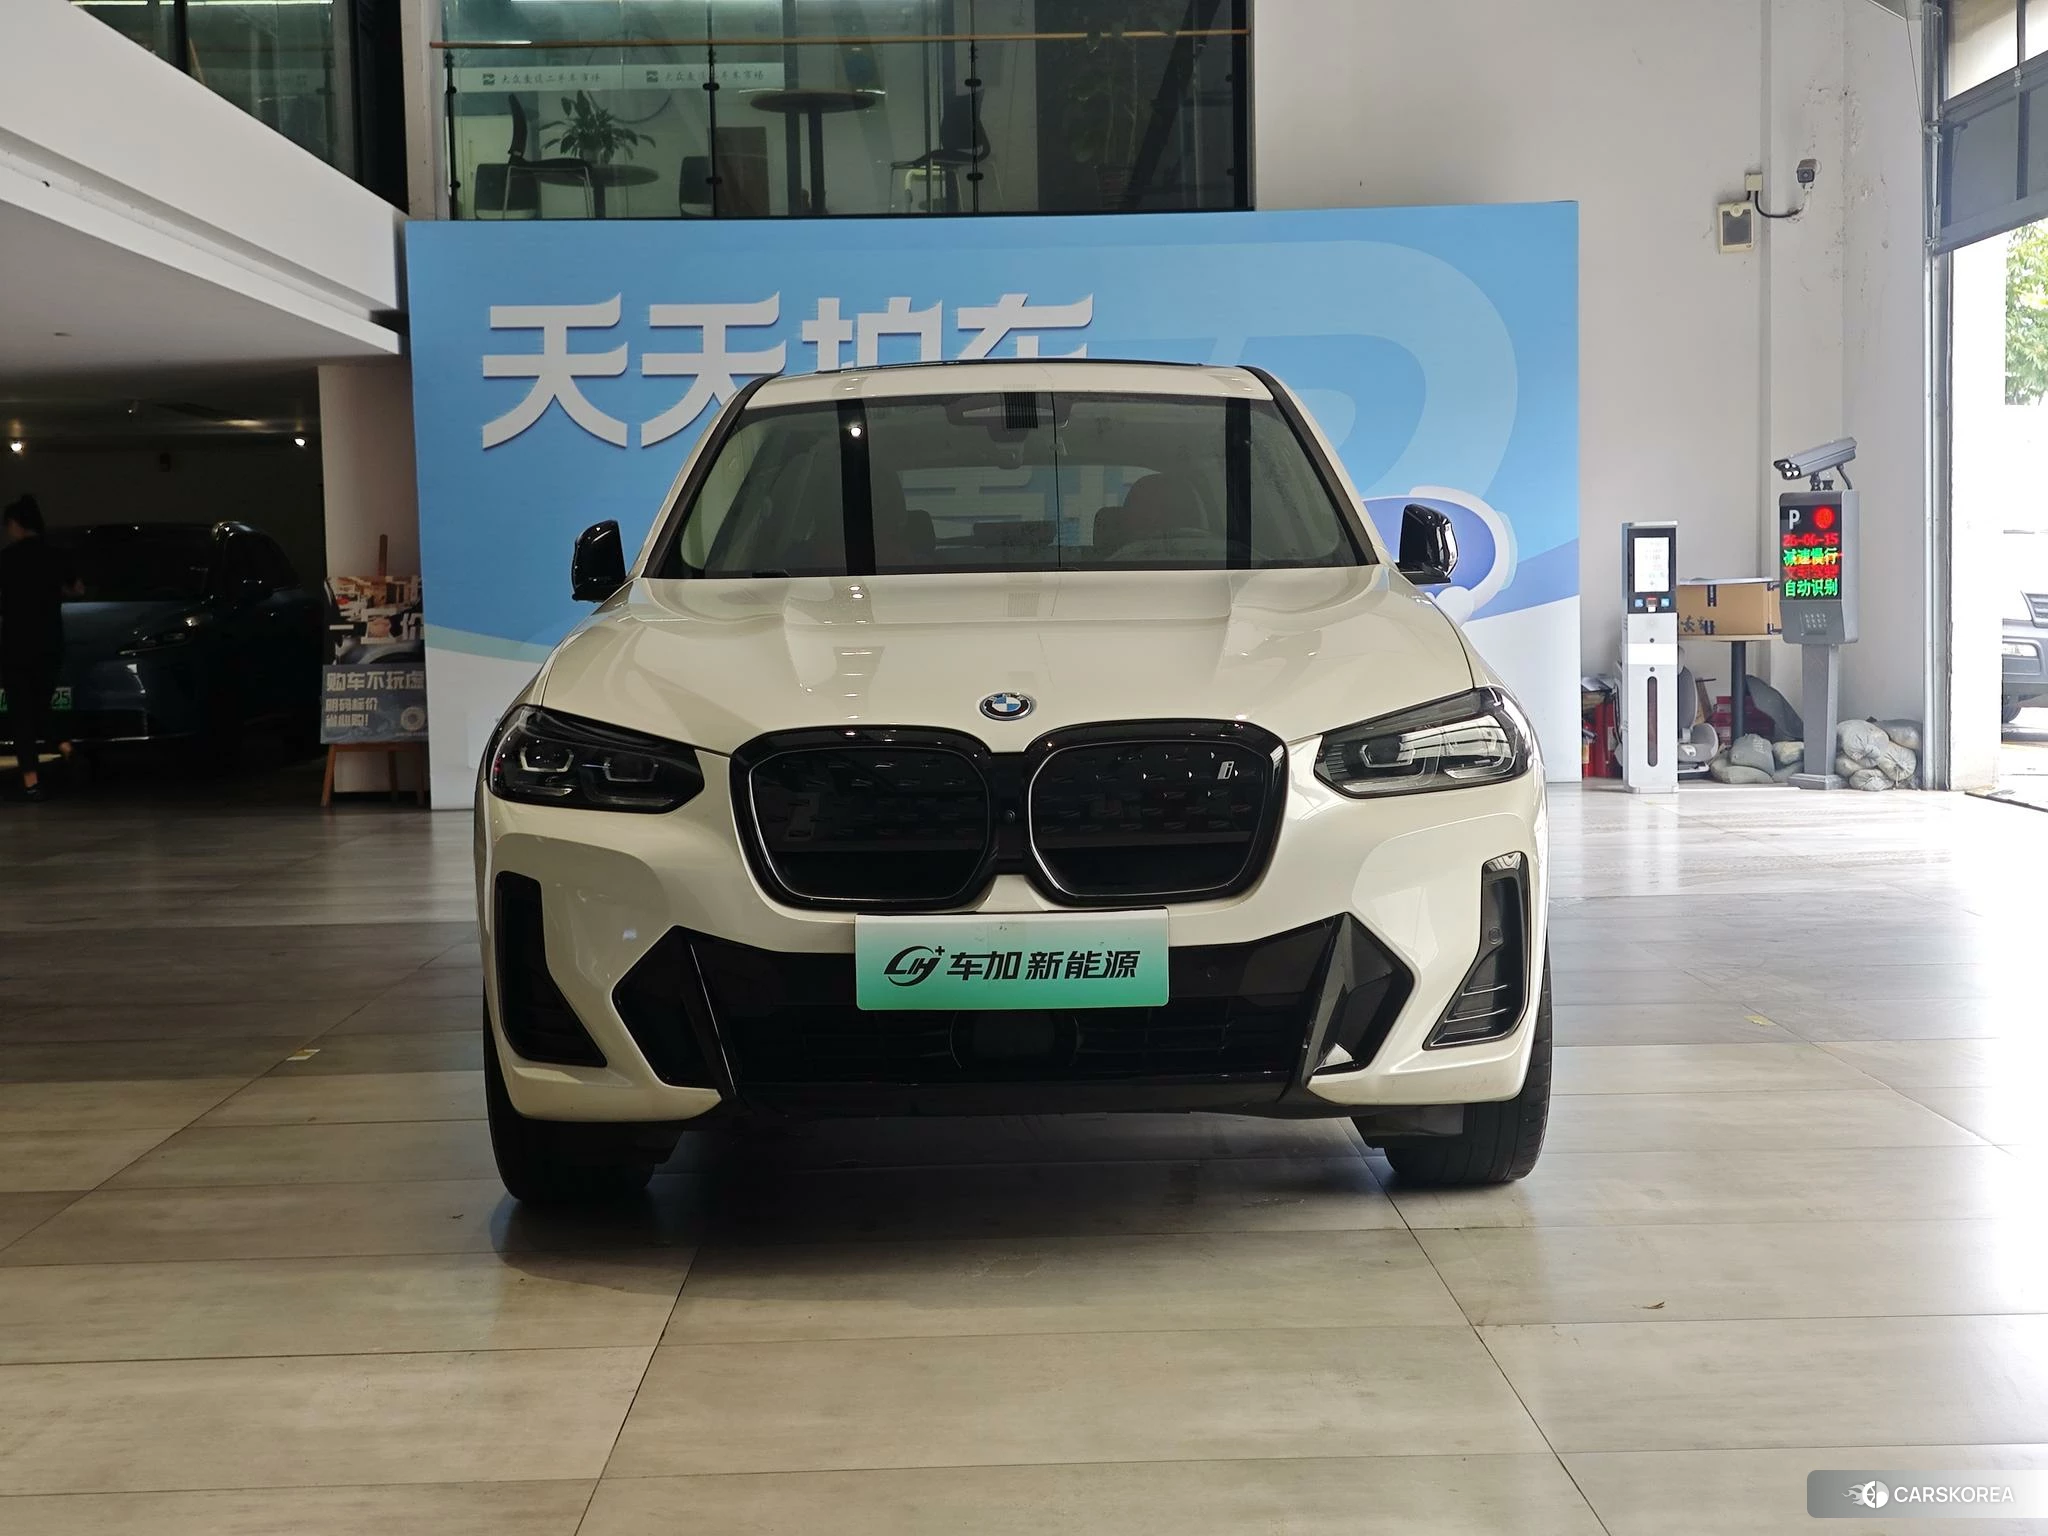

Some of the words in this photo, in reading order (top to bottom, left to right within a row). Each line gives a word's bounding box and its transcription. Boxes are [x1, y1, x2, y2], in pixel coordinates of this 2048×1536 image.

[1788, 509, 1800, 530] P
[1783, 547, 1838, 565] 减速慢行
[1785, 578, 1838, 596] 自动识别
[326, 671, 425, 692] 购车不玩虚
[325, 697, 378, 712] 明码标价
